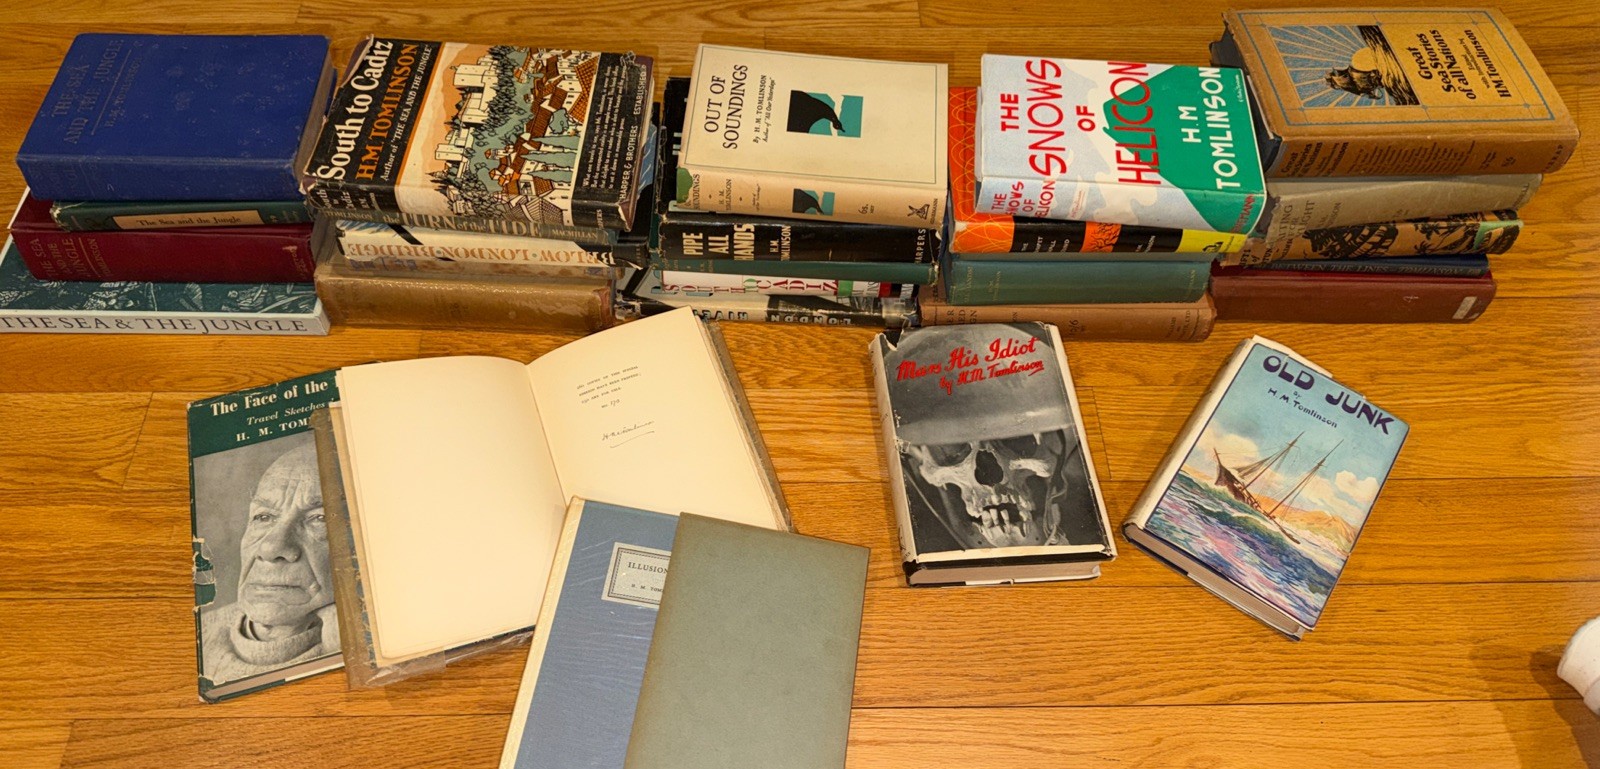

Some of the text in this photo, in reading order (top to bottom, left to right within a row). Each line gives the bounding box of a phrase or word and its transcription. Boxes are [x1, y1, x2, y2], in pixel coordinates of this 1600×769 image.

[1406, 46, 1433, 80] Great
[1416, 33, 1457, 93] Sea Stories
[1429, 29, 1477, 100] of all Nations
[317, 41, 393, 180] South to Cadiz
[704, 75, 726, 133] OUT OF
[722, 64, 748, 150] SOUNDINGS
[753, 74, 767, 144] By TOMLINSON
[1000, 93, 1020, 132] THE
[1025, 59, 1067, 176] SNOWS
[1075, 105, 1096, 132] OF
[380, 154, 396, 181] Author
[400, 108, 411, 122] SEA
[406, 91, 417, 107] AND
[412, 74, 423, 89] THE
[1107, 61, 1161, 185] HELICON
[1198, 67, 1241, 190] TOMLINSON
[625, 125, 639, 161] BROTHERS
[619, 160, 632, 199] HARPER
[991, 193, 1007, 210] THE
[1022, 199, 1035, 212] OF
[1034, 180, 1056, 219] ELICON
[178, 217, 193, 225] and
[196, 216, 211, 225] the
[213, 216, 242, 226] Jungle
[400, 212, 456, 231] TURN
[457, 220, 469, 231] of
[470, 220, 487, 232] the
[488, 219, 543, 238] TIDE
[551, 228, 598, 239] MACMILLAN
[348, 242, 435, 259] BRIDGE
[442, 246, 531, 262] LONDON
[682, 232, 704, 256] PIPE
[708, 234, 730, 255] ALL
[733, 223, 755, 261] HANDS
[0, 316, 308, 335] THE SEA & THE JUNGLE
[896, 336, 1041, 381] Mars His Idiot
[939, 375, 953, 395] by
[988, 358, 1044, 379] Tomlinson
[210, 401, 238, 417] The
[244, 392, 278, 410] Face
[283, 385, 299, 400] of
[304, 380, 329, 396] the
[246, 401, 326, 426] Travel Sketches
[1263, 355, 1394, 435] OLD JUNK
[1292, 399, 1338, 428] Tomlinson
[236, 426, 273, 442] H. M.
